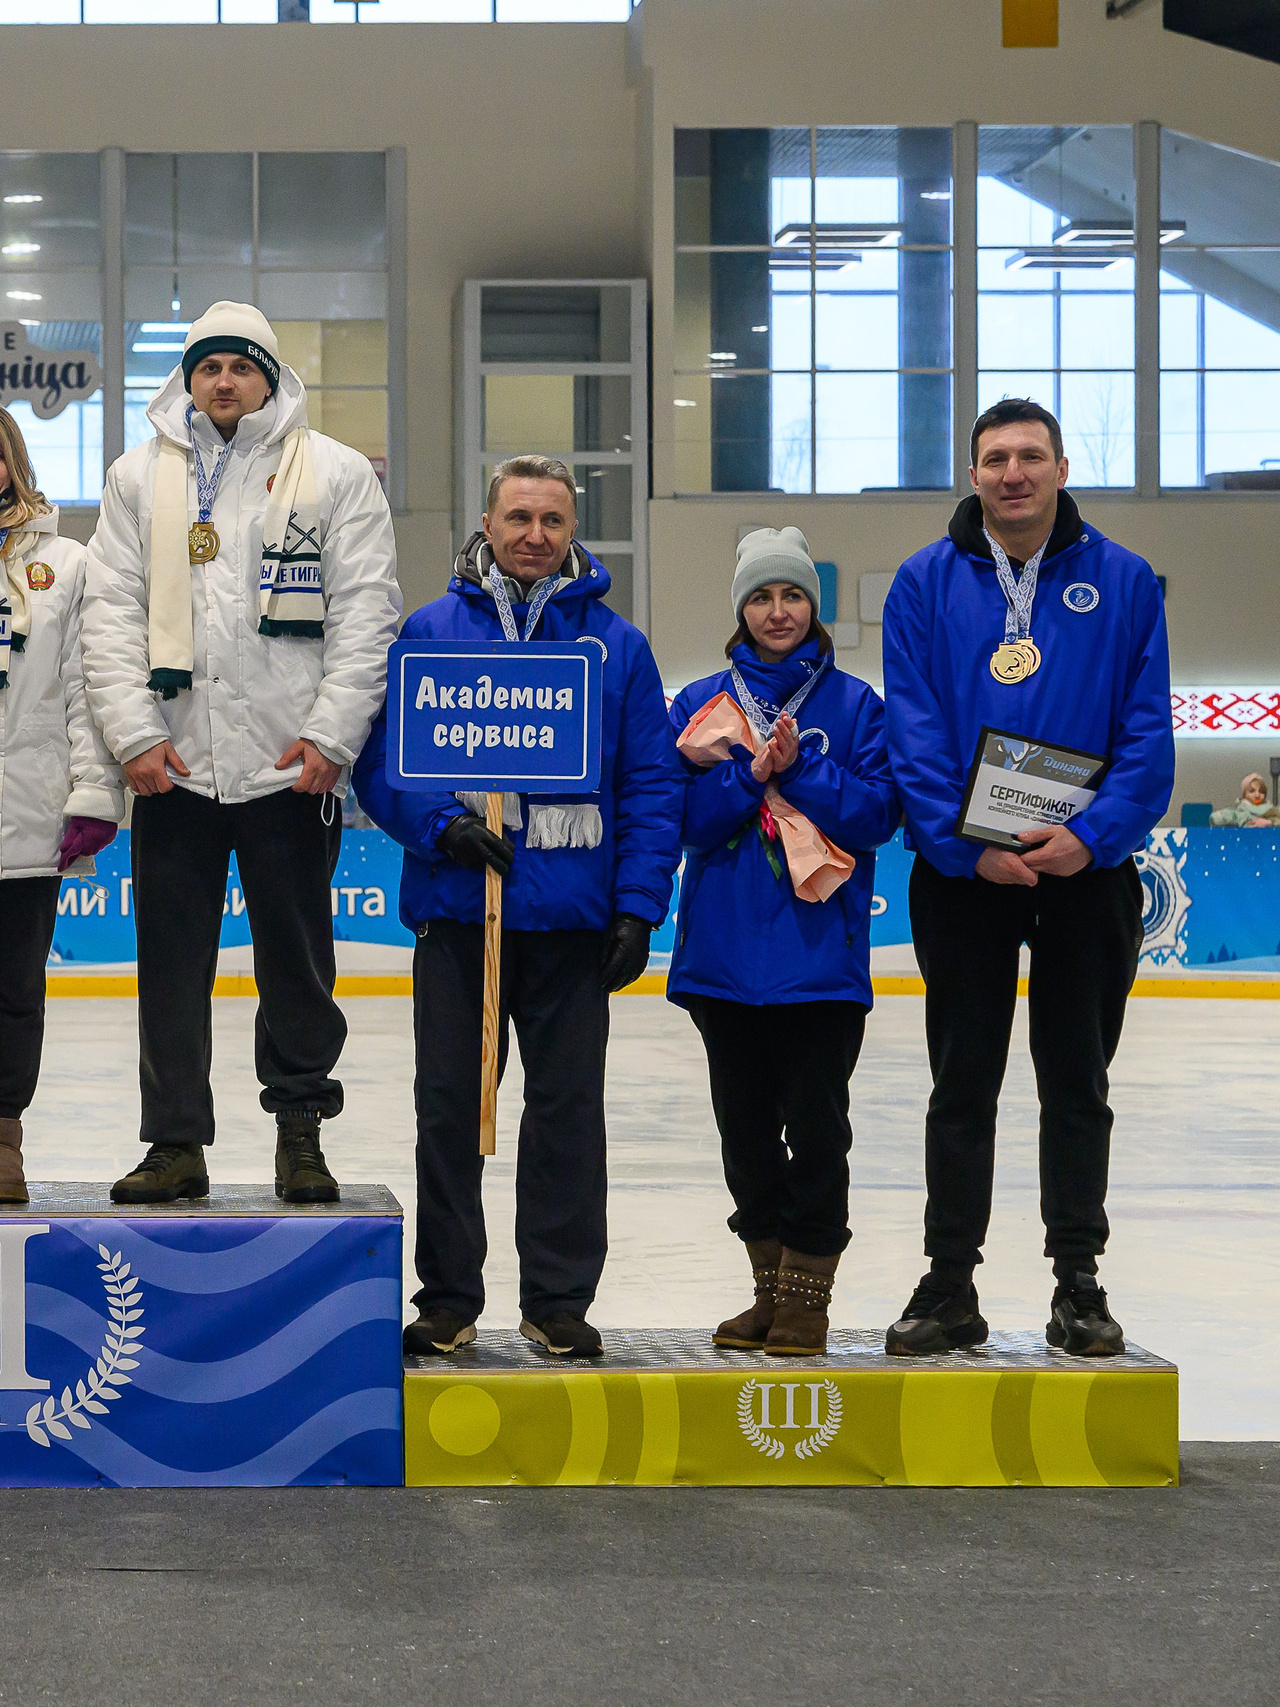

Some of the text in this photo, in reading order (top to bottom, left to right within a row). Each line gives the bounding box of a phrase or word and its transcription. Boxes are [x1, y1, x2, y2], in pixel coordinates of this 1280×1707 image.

[247, 344, 279, 381] БЕЛАРУСЬ
[414, 674, 574, 711] Академия
[433, 721, 555, 758] сервиса
[989, 784, 1077, 817] СЕРТИФИКАТ
[755, 1383, 825, 1429] III
